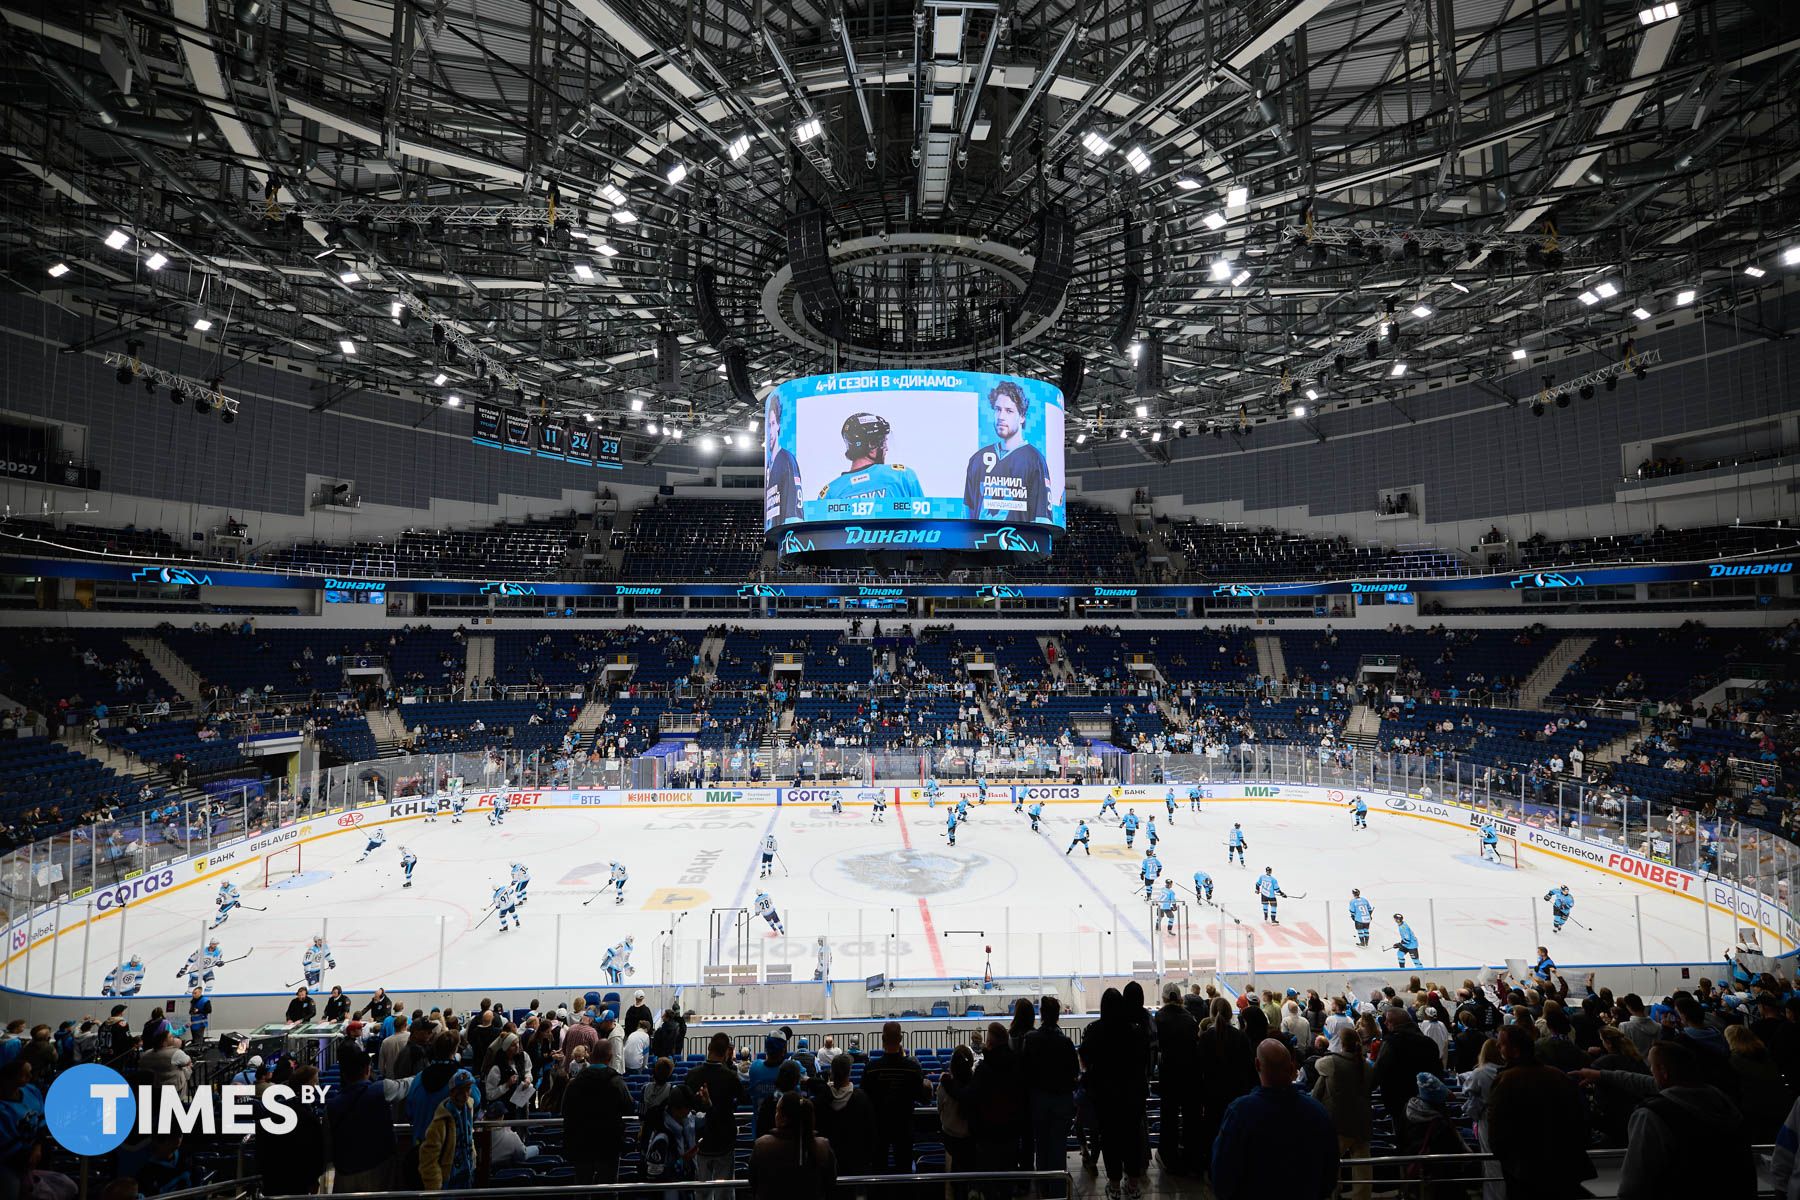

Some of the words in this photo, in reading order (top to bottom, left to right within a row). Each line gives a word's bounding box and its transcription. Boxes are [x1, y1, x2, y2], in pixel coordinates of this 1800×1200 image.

[816, 377, 836, 391] 4-Й
[839, 377, 878, 390] СЕЗОН
[882, 376, 890, 387] В
[893, 375, 962, 388] «ДИНАМО»
[545, 429, 556, 443] 11
[572, 436, 588, 449] 24
[602, 440, 618, 454] 29
[983, 452, 996, 473] 9
[983, 475, 1022, 488] ДАНИИЛ
[983, 486, 1028, 499] ЛИПСКИЙ
[828, 503, 851, 513] РОСТ:
[851, 501, 875, 516] 187
[893, 502, 911, 511] ВЕС:
[912, 501, 931, 515] 90
[705, 791, 743, 803] МИР
[1245, 786, 1280, 798] МИР
[580, 795, 601, 805] ВТБ
[1418, 803, 1449, 818] LADA
[250, 820, 298, 852] GISLAVED
[1536, 833, 1604, 864] Ростелеком
[209, 850, 235, 867] БАНК
[1608, 853, 1694, 892] FONBET
[500, 891, 509, 903] 97
[759, 899, 770, 910] 28
[1714, 887, 1771, 926] Belava
[30, 921, 55, 942] elbet
